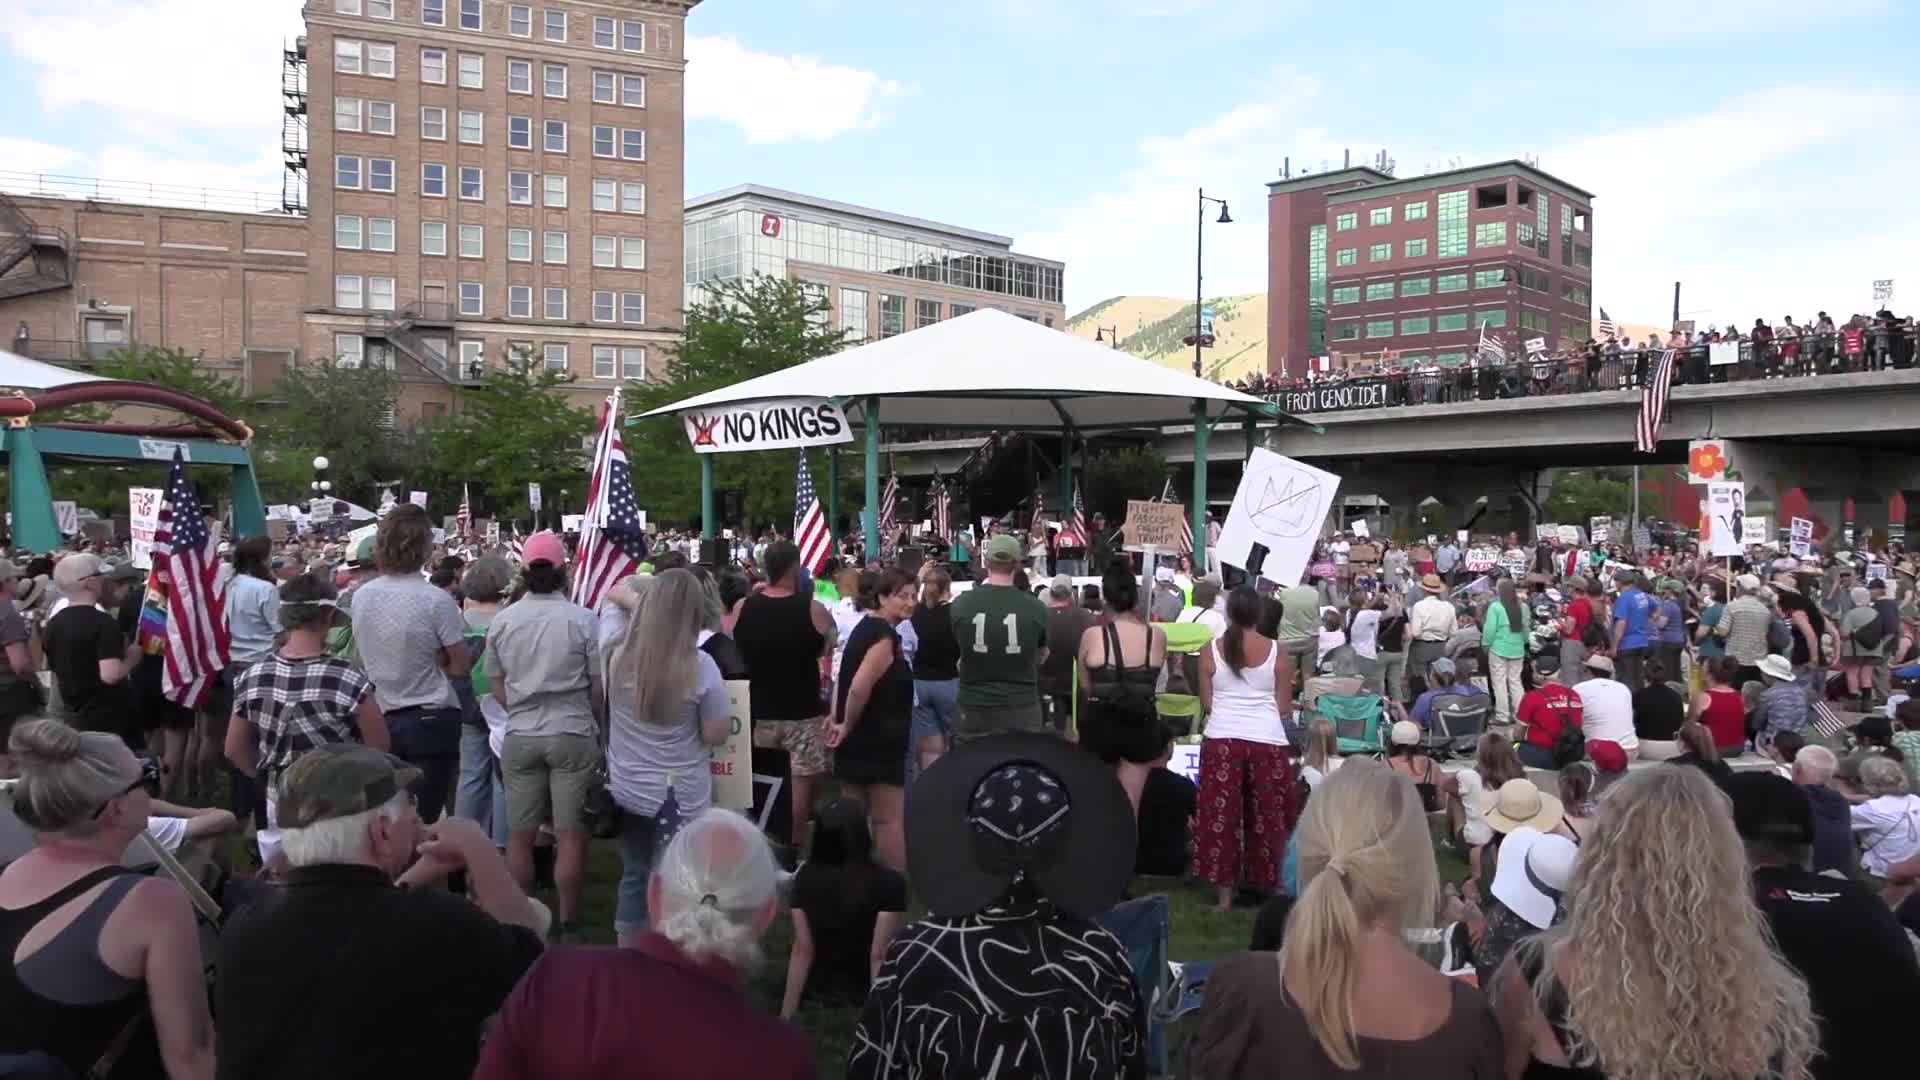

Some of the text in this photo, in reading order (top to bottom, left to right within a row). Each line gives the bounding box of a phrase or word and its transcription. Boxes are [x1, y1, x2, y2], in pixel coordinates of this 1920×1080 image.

[1286, 391, 1316, 412] FROM
[1320, 384, 1387, 409] GENOCIDE!
[724, 404, 842, 444] NO KINGS
[972, 612, 1021, 654] 11
